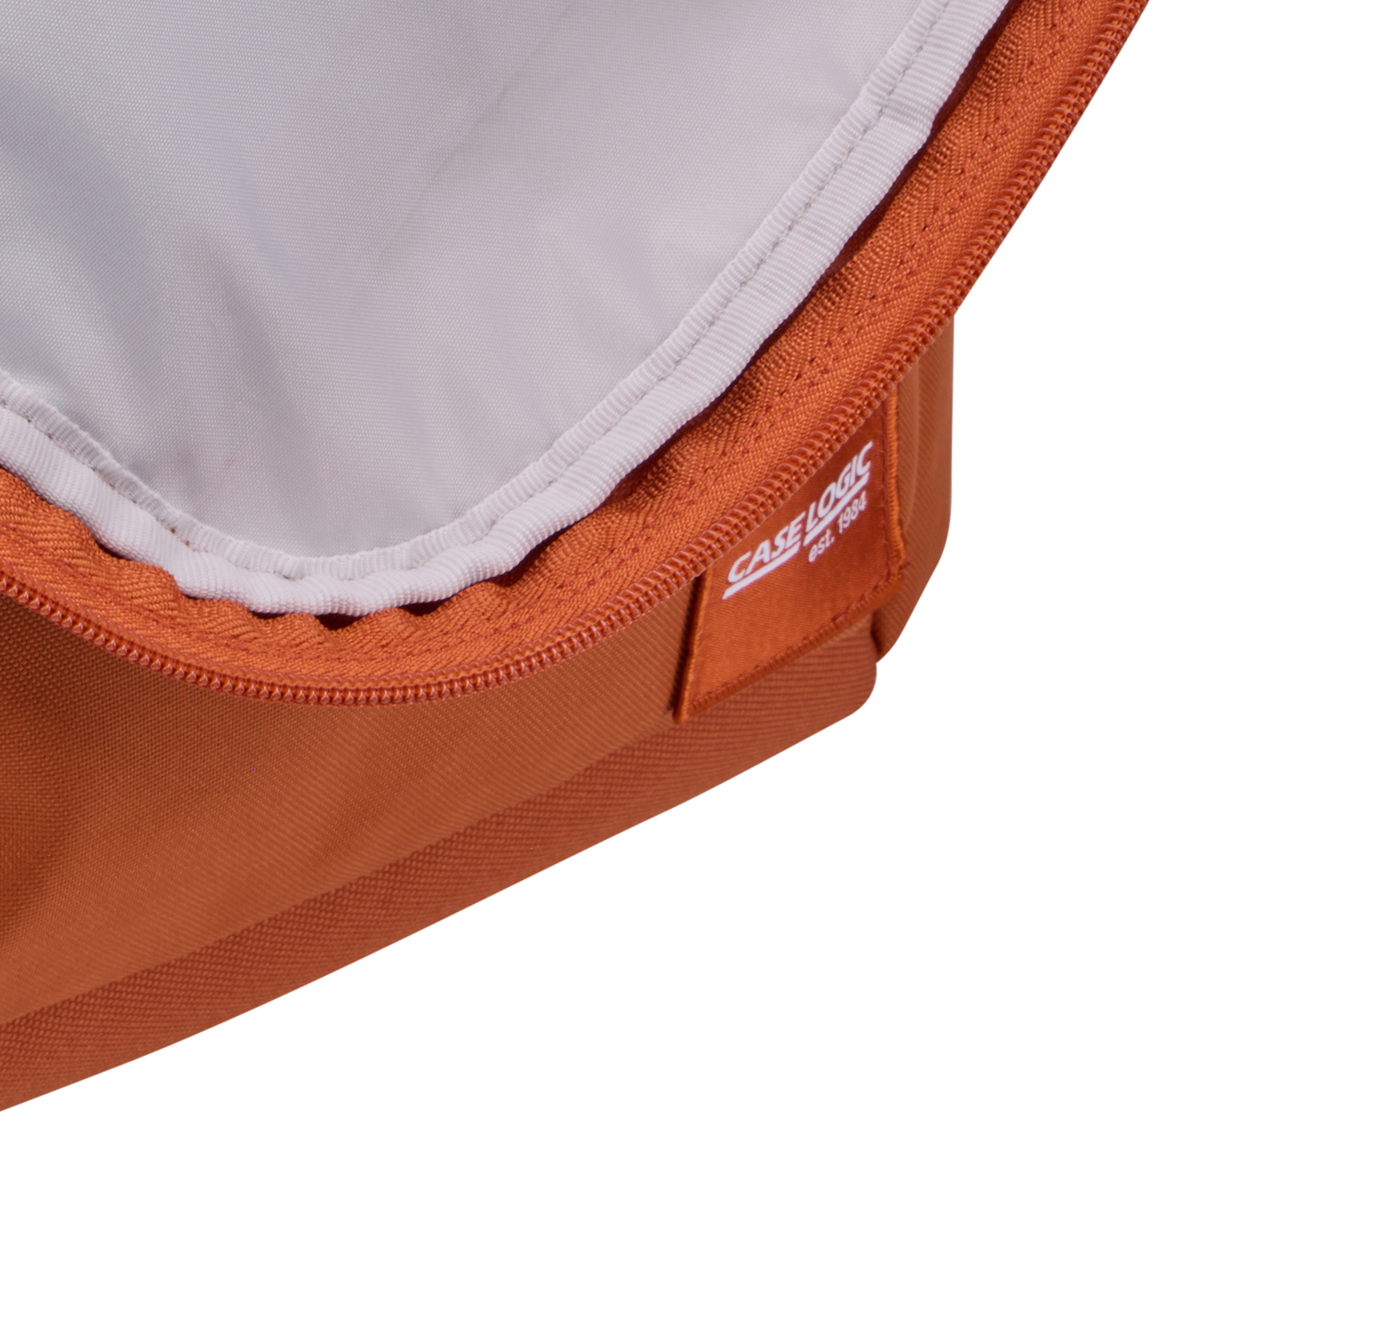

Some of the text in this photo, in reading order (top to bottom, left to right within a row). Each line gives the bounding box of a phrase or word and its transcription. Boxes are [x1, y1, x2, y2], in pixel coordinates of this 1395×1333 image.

[727, 440, 874, 583] CASE LOGIC
[808, 490, 867, 563] est. 1984
